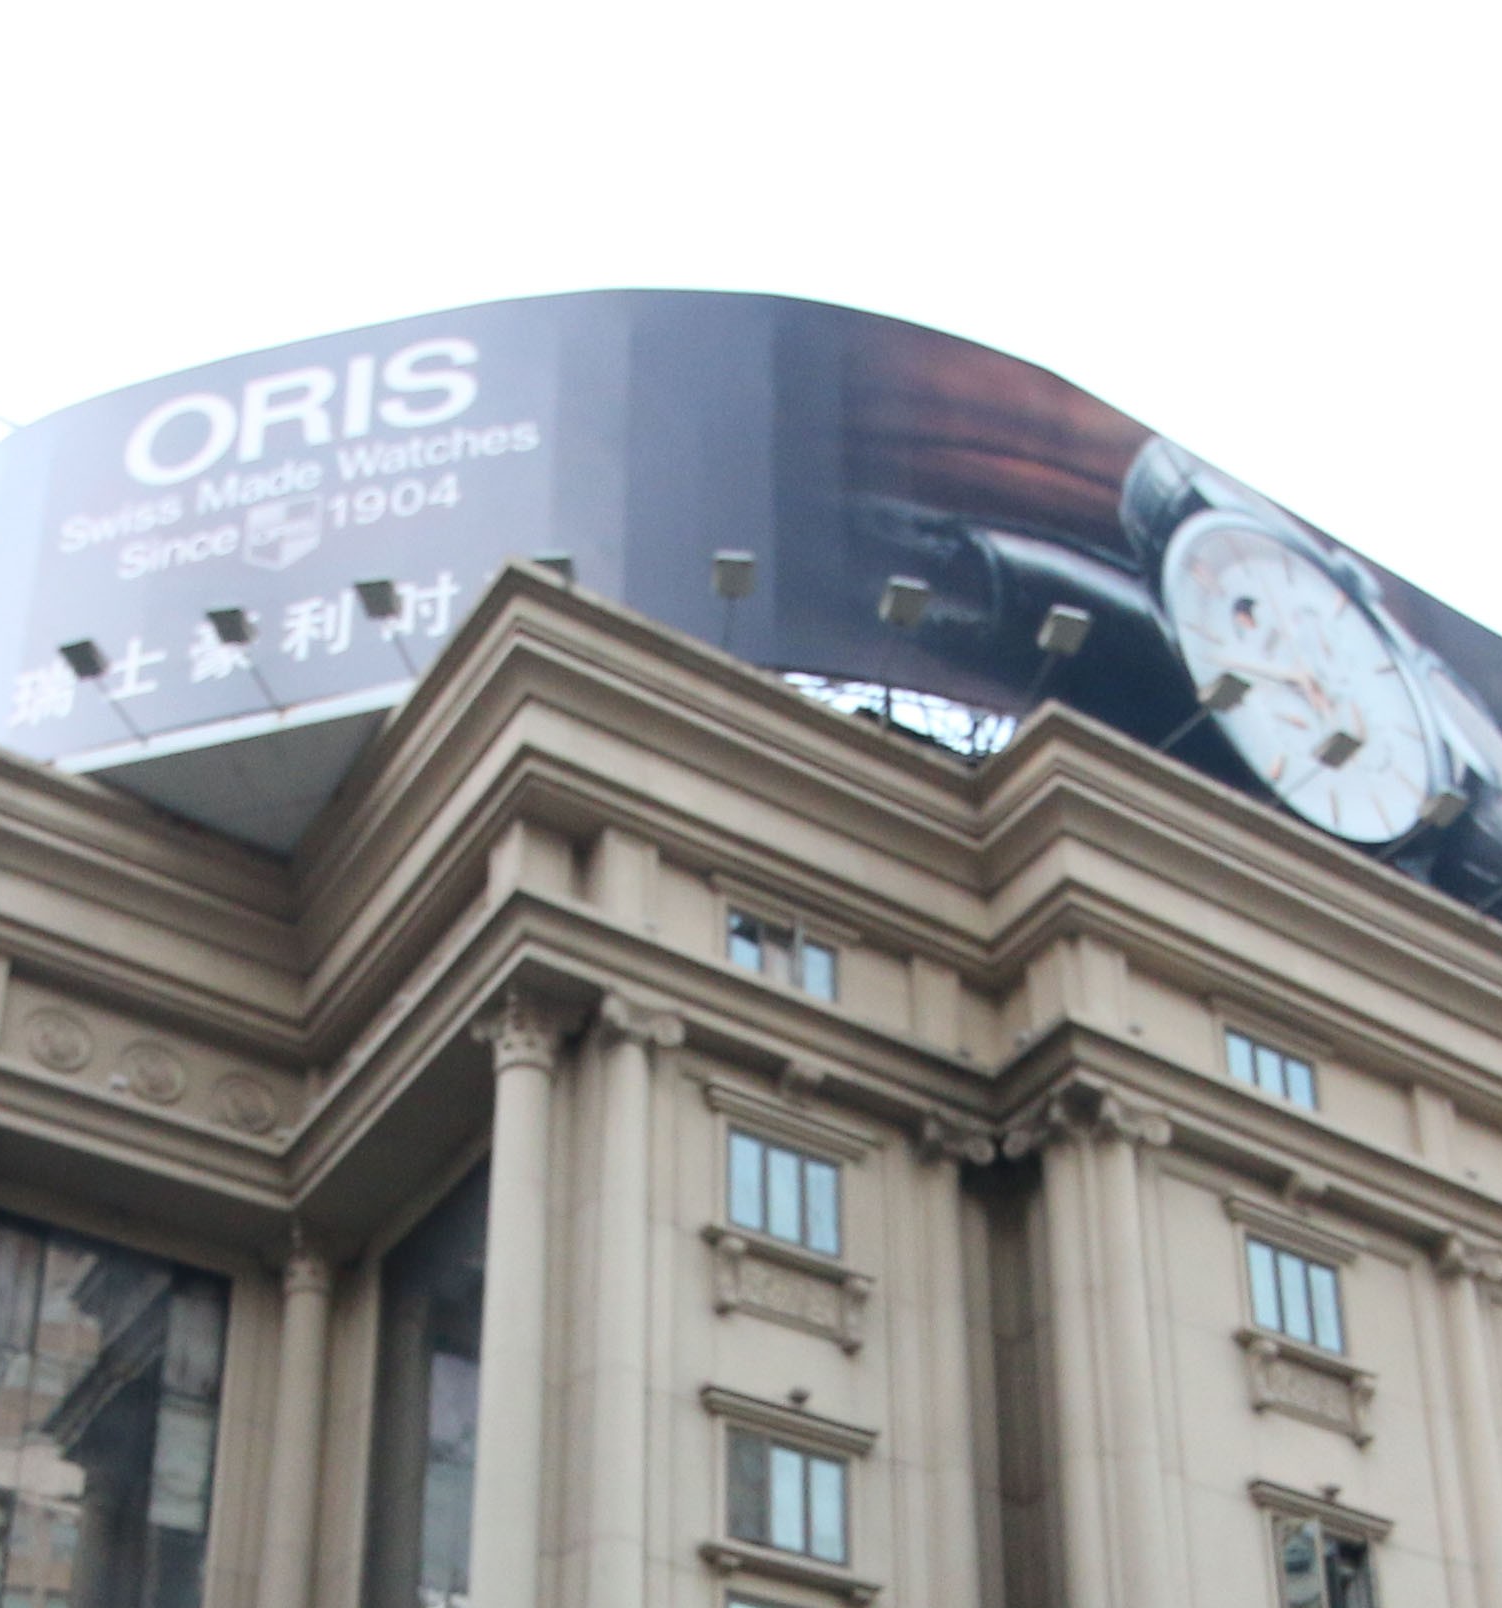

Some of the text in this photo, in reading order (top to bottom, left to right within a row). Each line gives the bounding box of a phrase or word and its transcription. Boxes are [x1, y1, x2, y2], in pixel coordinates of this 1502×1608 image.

[123, 336, 480, 487] ORIS
[58, 420, 541, 553] Swiss Made Watches
[117, 472, 461, 580] Since 1904
